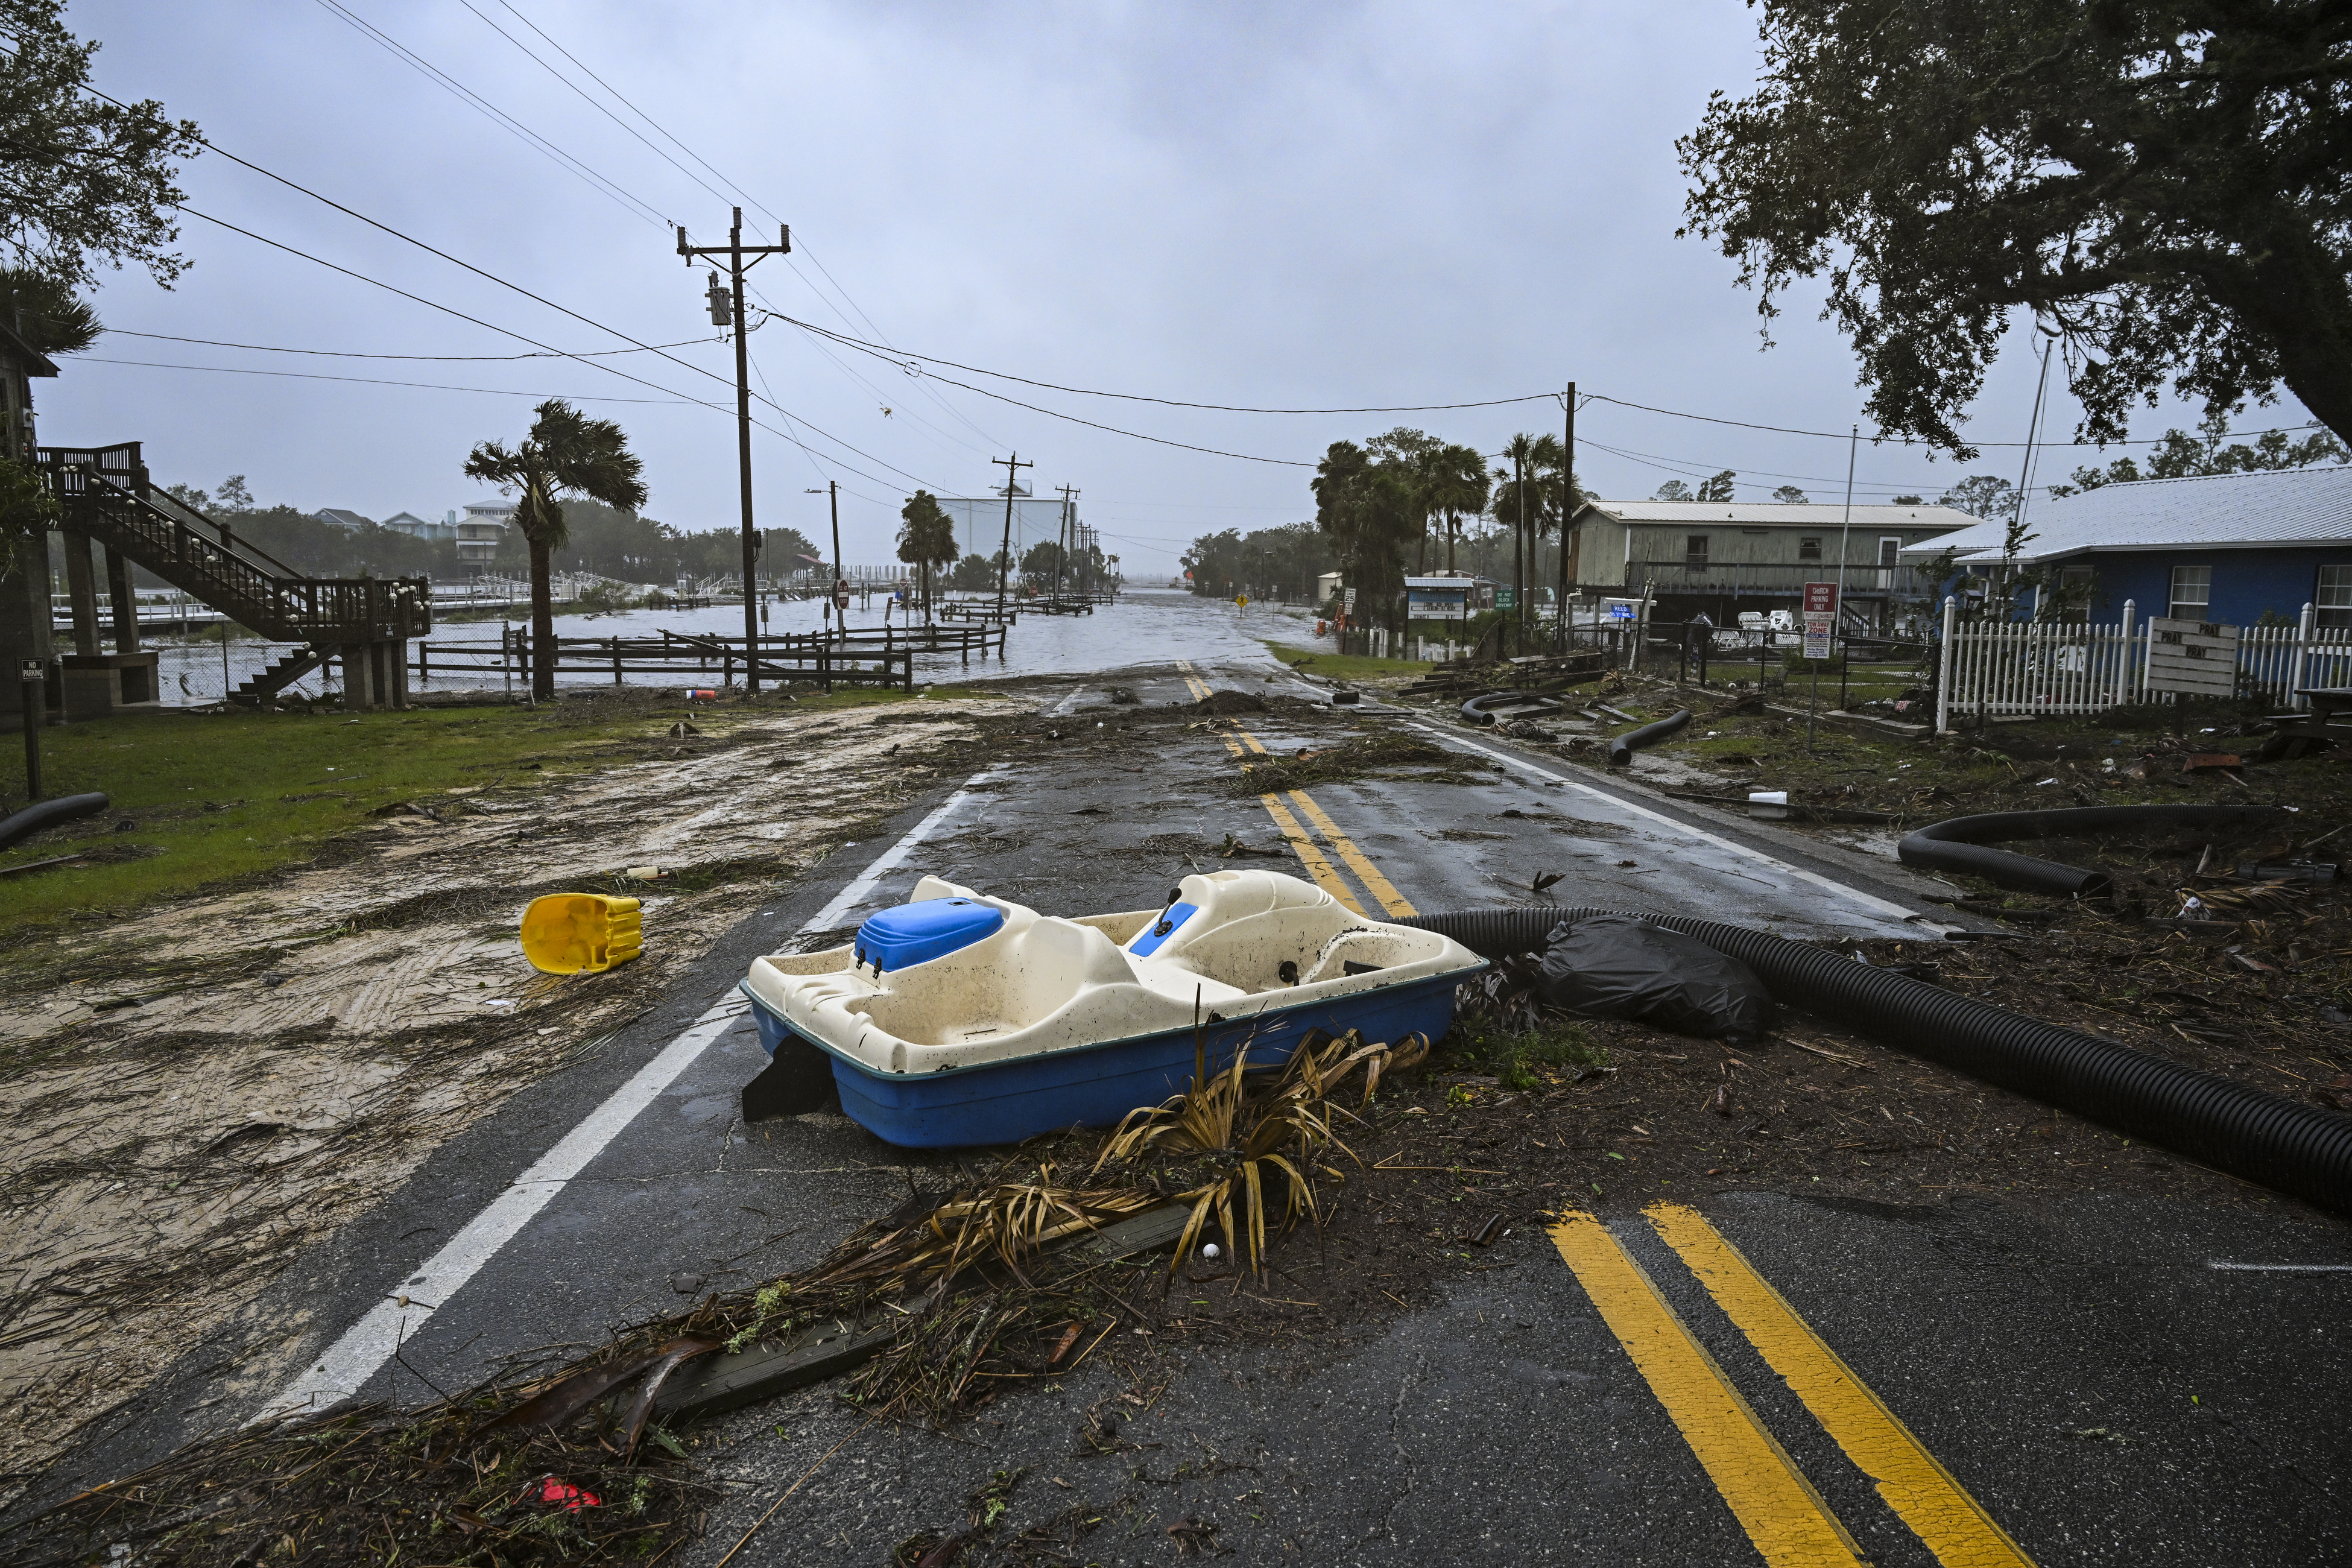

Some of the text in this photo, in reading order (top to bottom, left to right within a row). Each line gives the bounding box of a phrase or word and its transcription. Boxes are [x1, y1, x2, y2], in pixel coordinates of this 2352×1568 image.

[2161, 631, 2183, 643] PRAY
[2199, 624, 2220, 637] PRAY
[2186, 645, 2207, 658] PRAY
